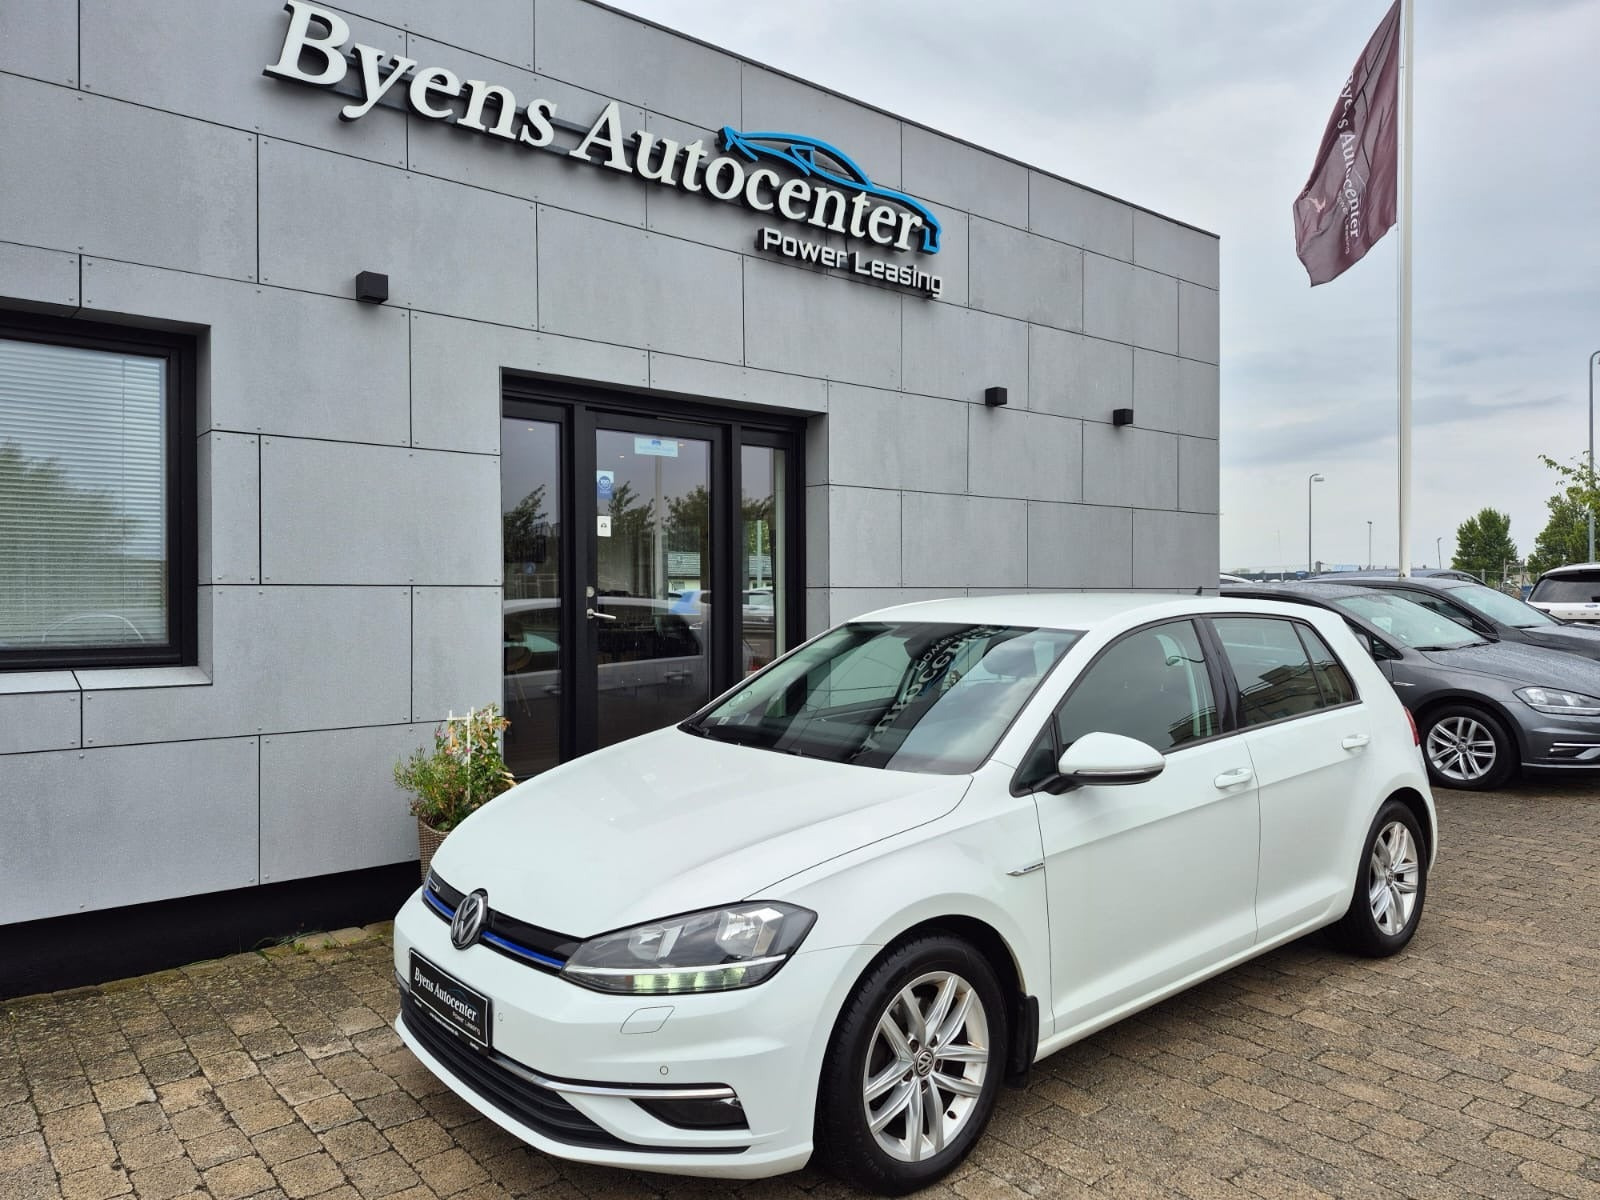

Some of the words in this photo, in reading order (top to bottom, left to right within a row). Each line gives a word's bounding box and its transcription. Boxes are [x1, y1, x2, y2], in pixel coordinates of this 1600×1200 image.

[264, 0, 557, 147] Byens
[569, 101, 923, 251] Autocenter
[1337, 71, 1353, 129] Byes
[763, 226, 848, 269] Power
[854, 250, 943, 298] Leasing
[414, 966, 434, 993] Byens
[433, 982, 477, 1021] Autocenter
